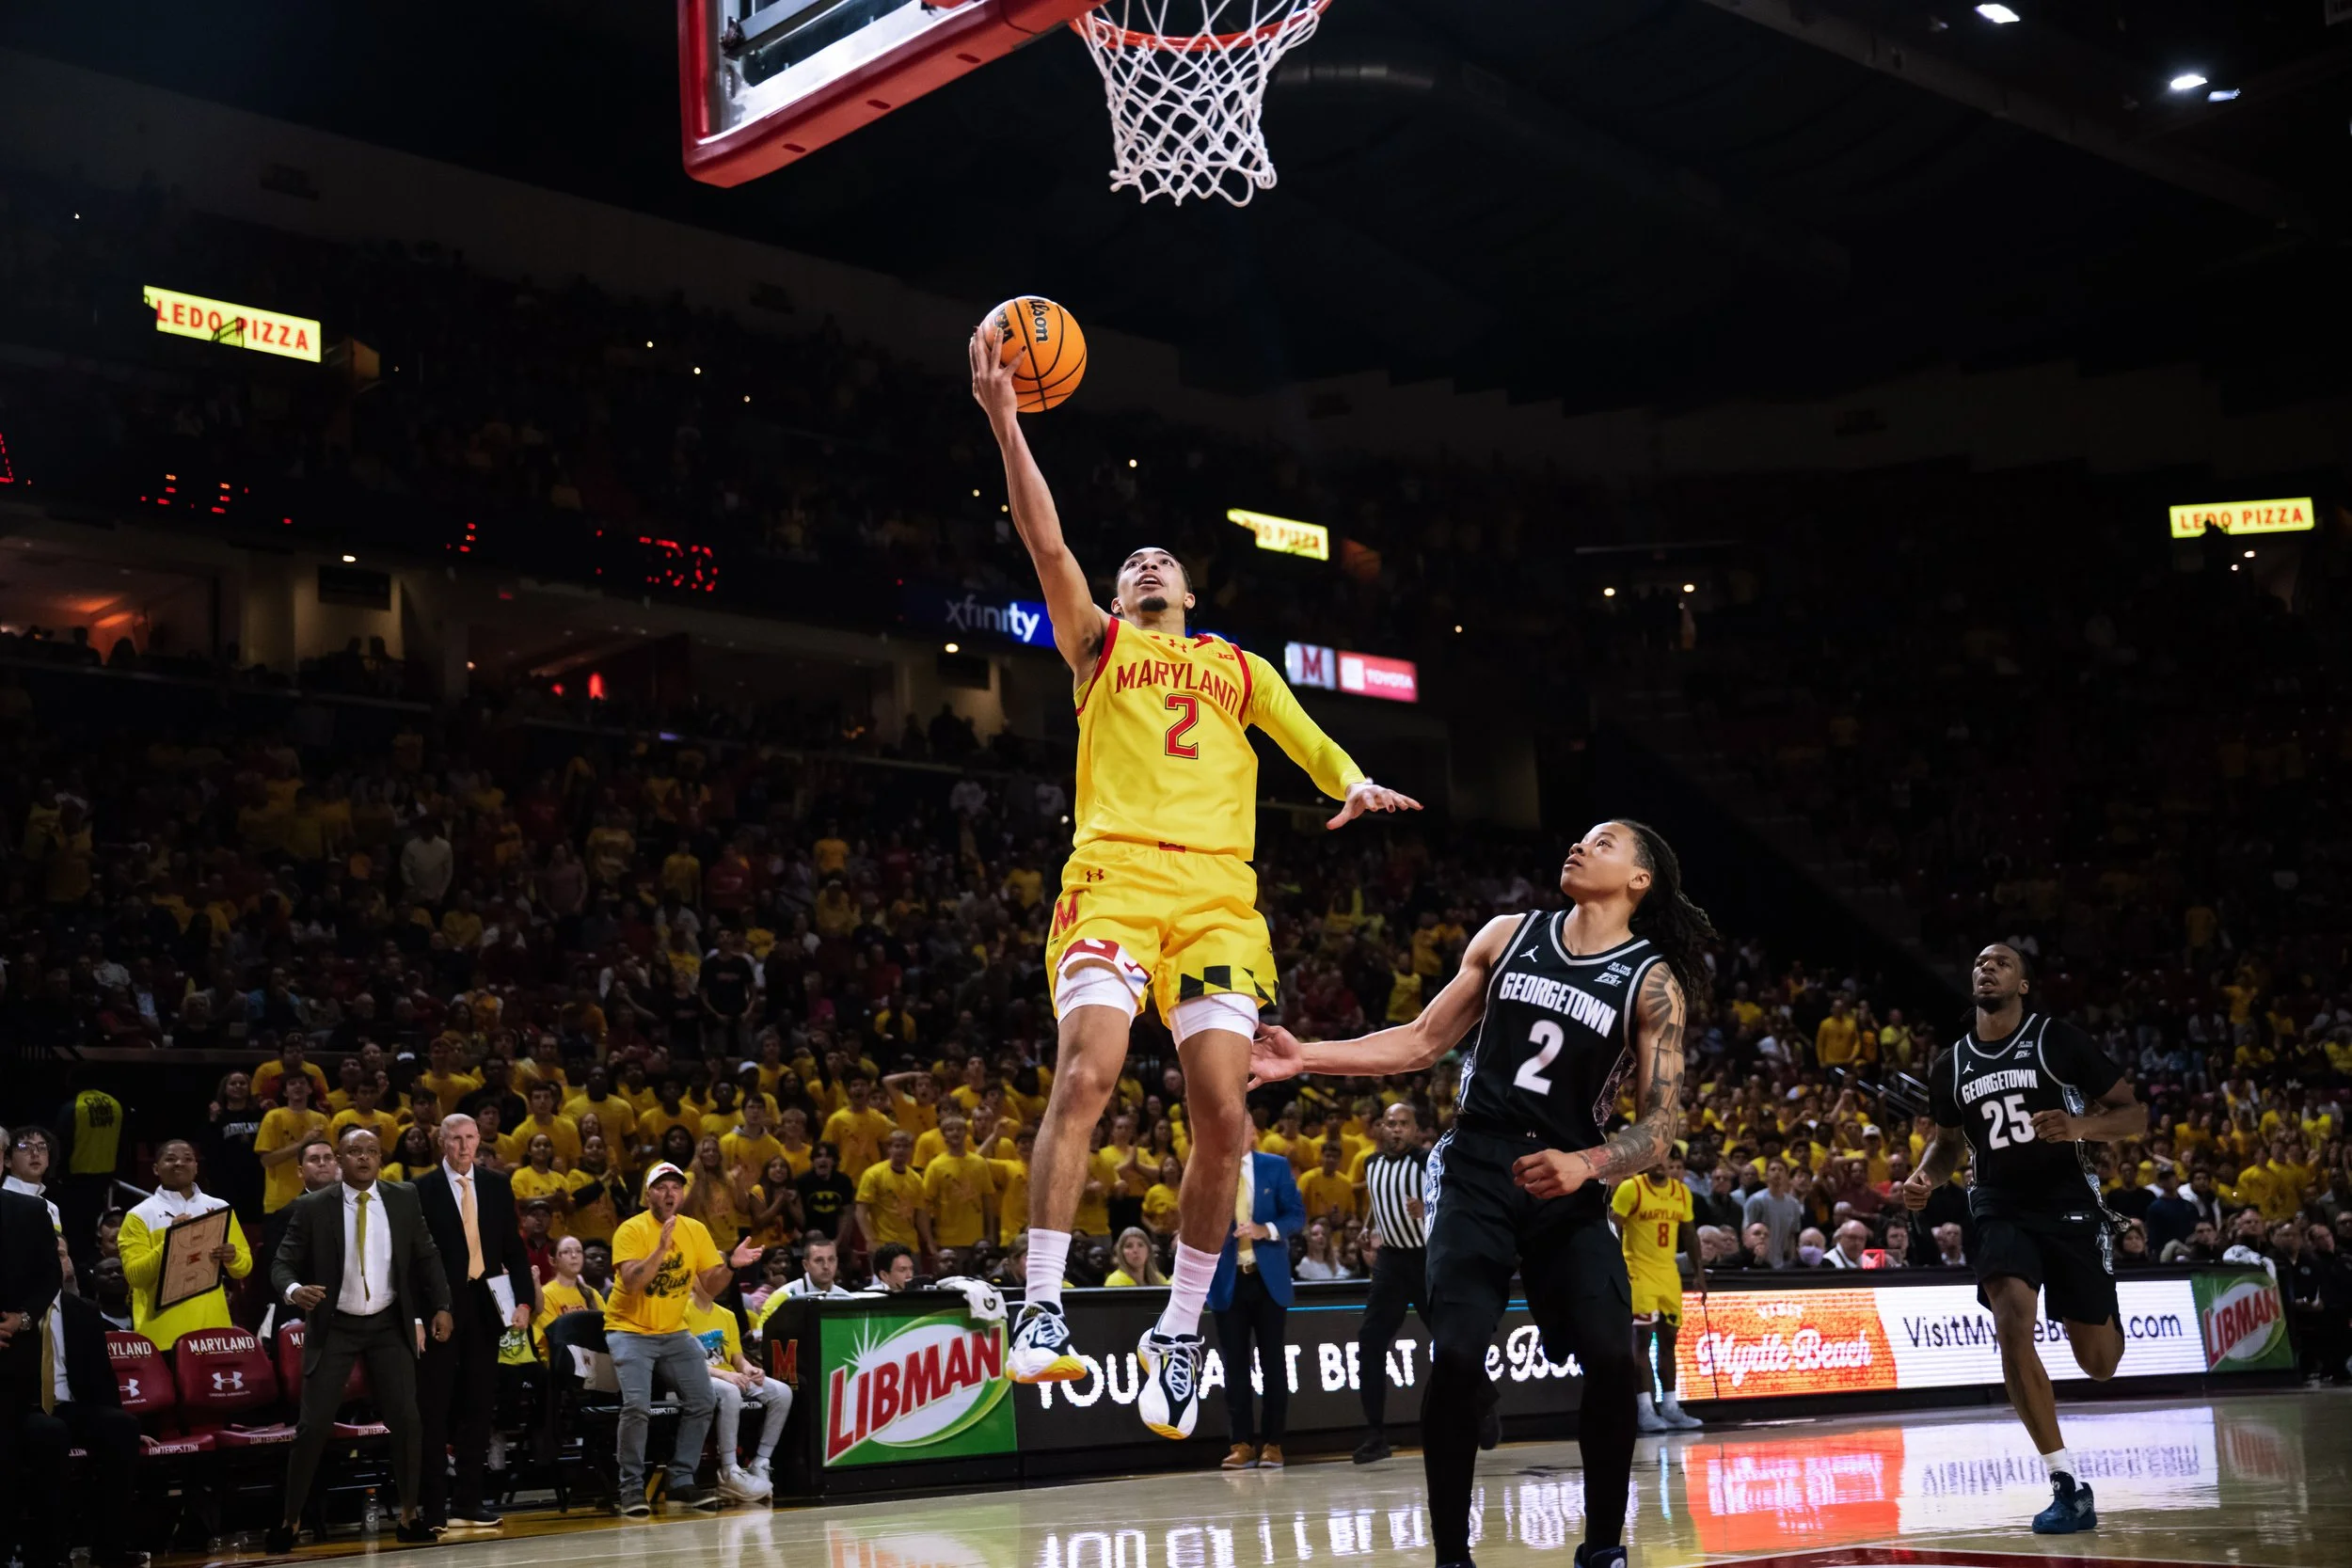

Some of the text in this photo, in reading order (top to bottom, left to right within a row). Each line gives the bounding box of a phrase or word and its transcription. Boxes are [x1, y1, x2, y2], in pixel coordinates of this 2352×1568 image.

[156, 300, 309, 351] LEDO PIZZA
[1025, 298, 1051, 344] ilson
[2180, 508, 2304, 530] LEDO PIZZA
[945, 593, 1041, 642] xfinity
[1114, 658, 1239, 716] MARYLAND
[1300, 646, 1324, 683] M
[1165, 693, 1199, 759] 2
[1053, 891, 1081, 939] M
[1498, 972, 1618, 1038] GEORGETOWN
[1513, 1019, 1565, 1096] 2
[1961, 1069, 2039, 1105] GEORGETOWN
[1980, 1093, 2036, 1150] 25
[1658, 1223, 1670, 1248] 8
[1756, 1302, 1804, 1320] VISIT
[2204, 1285, 2280, 1368] LIBMAN
[188, 1336, 255, 1354] MARYLAND
[771, 1338, 798, 1384] M
[1695, 1328, 1874, 1387] Myrtle Beach
[827, 1326, 1002, 1463] LIBMAN
